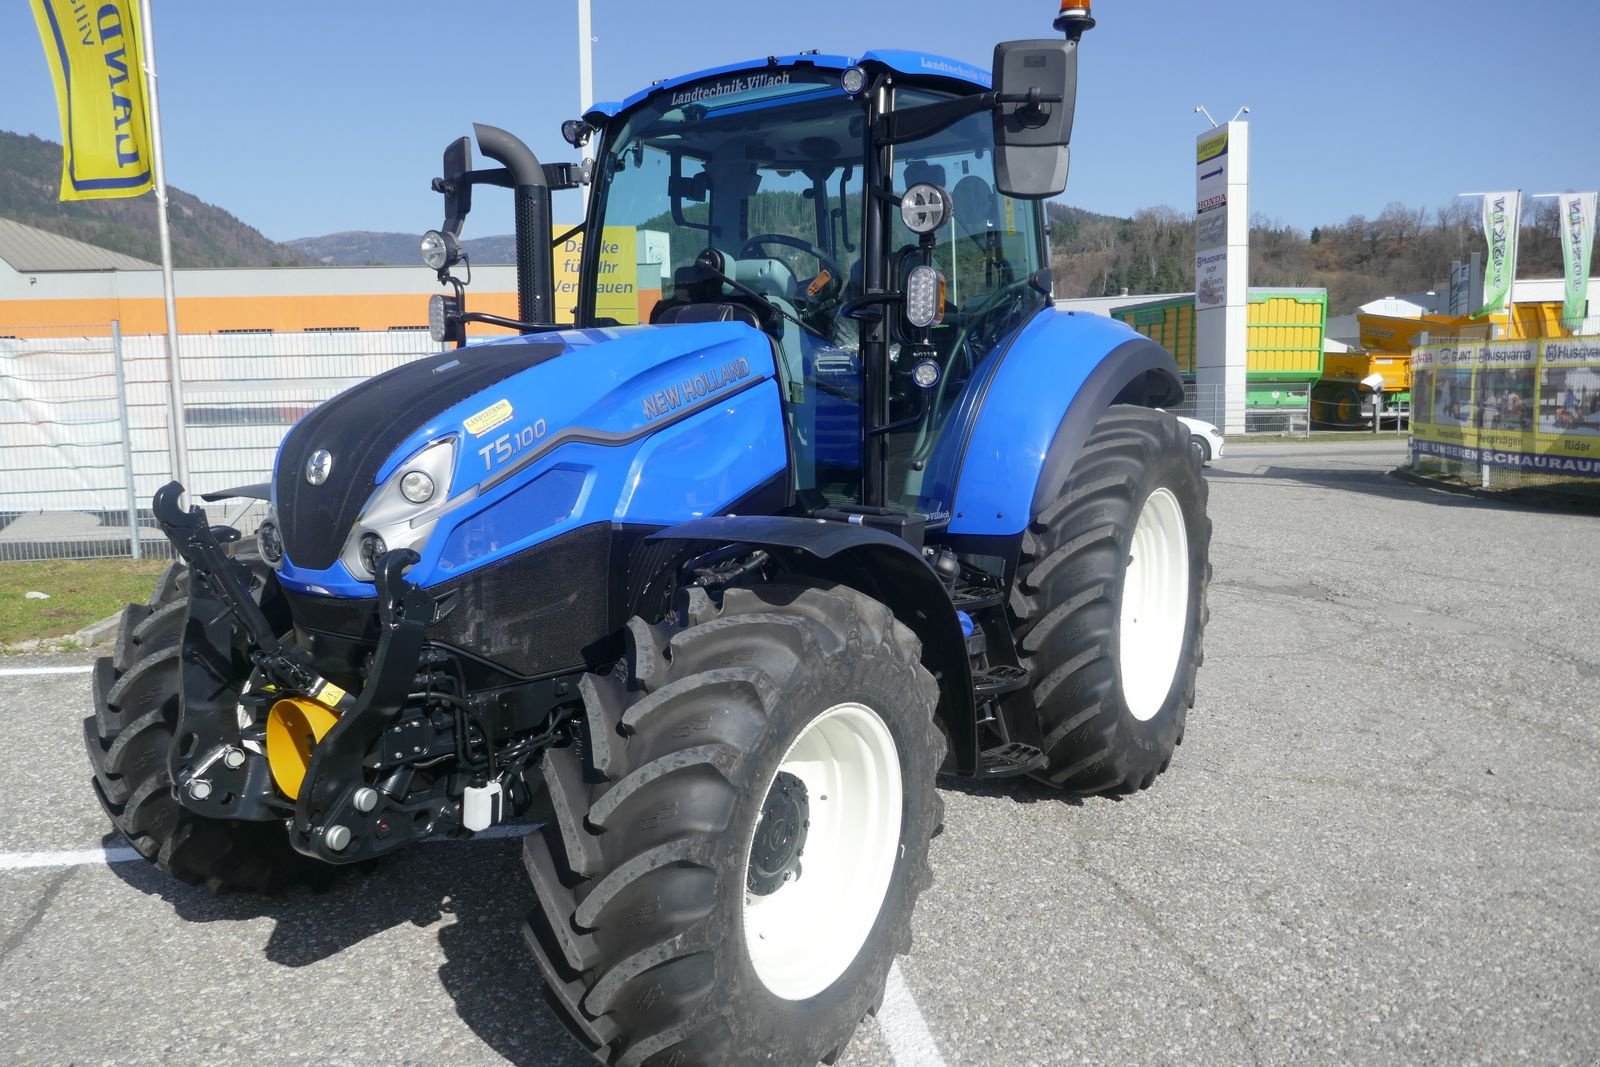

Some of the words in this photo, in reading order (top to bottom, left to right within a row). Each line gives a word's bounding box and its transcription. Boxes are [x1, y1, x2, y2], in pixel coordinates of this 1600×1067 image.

[671, 71, 789, 106] Landtechnik-Villach
[1198, 194, 1226, 209] HONDA
[564, 240, 619, 254] Dake
[564, 259, 581, 273] fü
[554, 280, 633, 293] Verauen
[1557, 345, 1600, 360] Husqva
[642, 384, 682, 420] NEW
[682, 357, 750, 403] HOLLAND
[1432, 444, 1477, 460] UNSEREN
[1564, 440, 1591, 451] Rider
